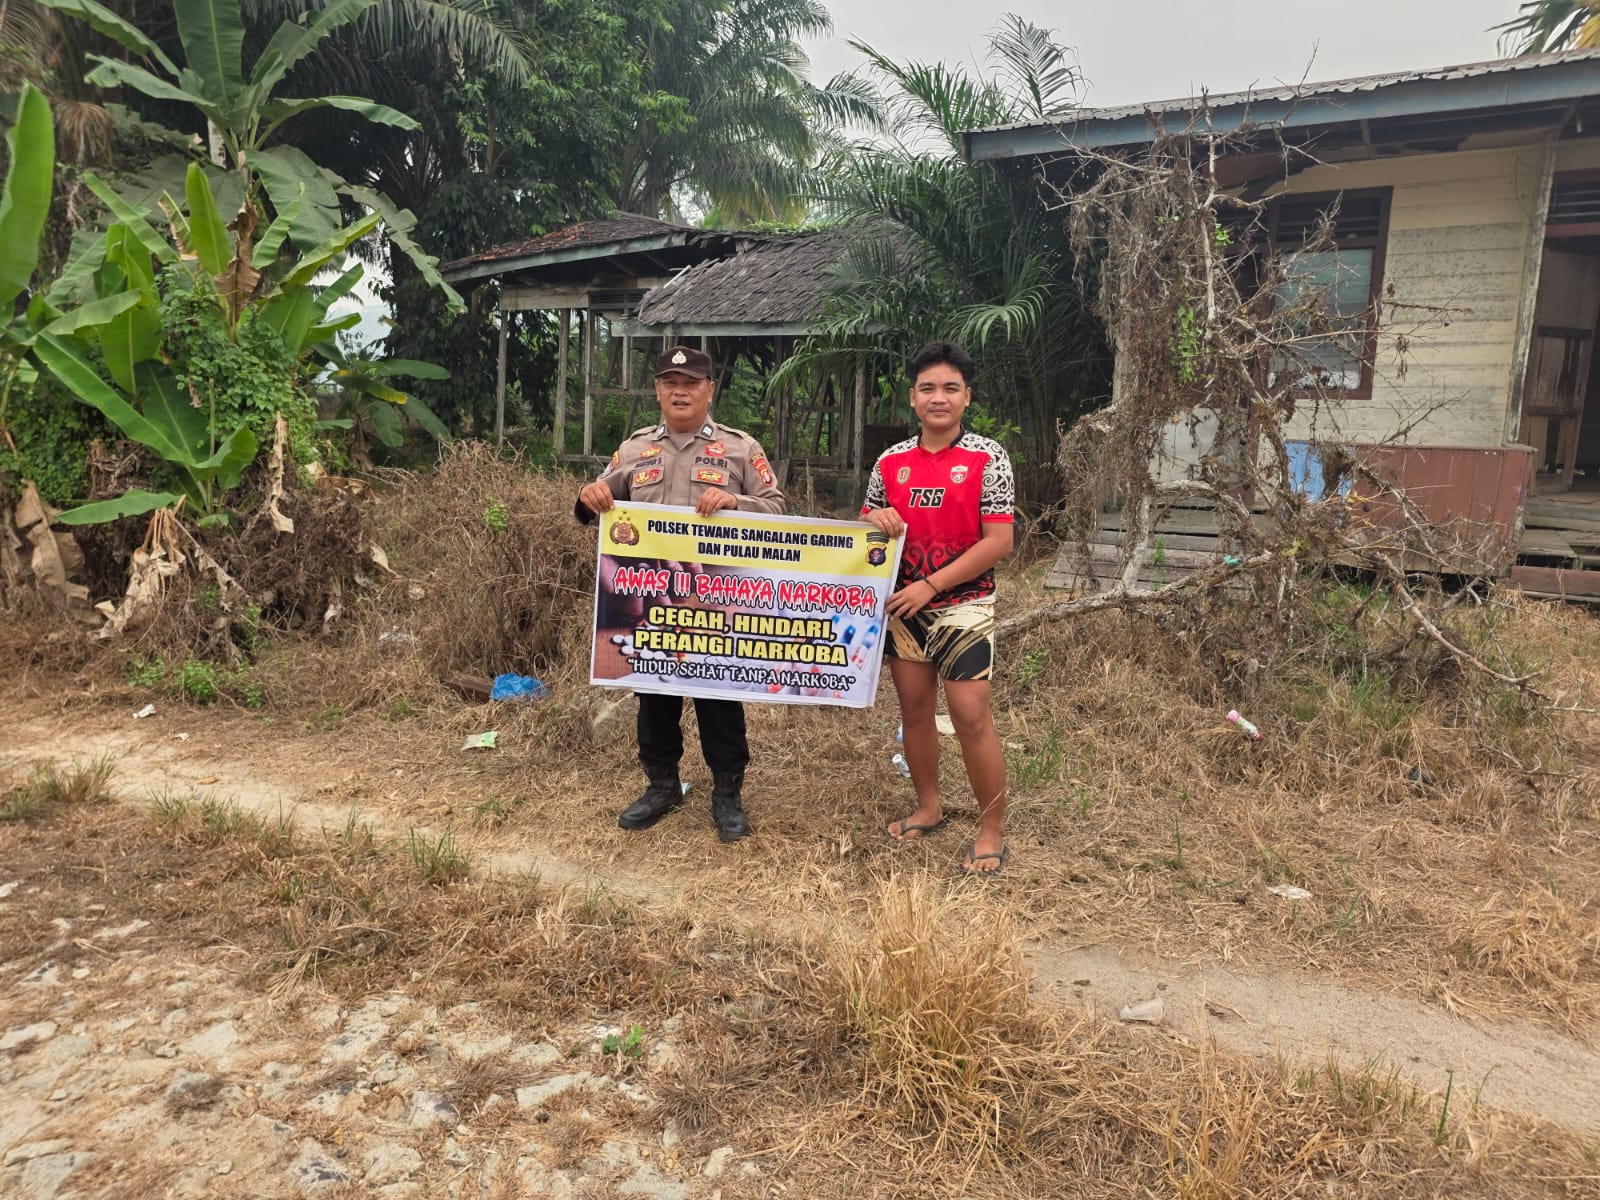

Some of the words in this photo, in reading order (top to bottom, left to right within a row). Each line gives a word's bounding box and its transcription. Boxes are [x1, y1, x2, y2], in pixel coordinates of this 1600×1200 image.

[695, 457, 728, 469] POLRI
[909, 487, 945, 508] TSG
[647, 519, 689, 536] POLSEK
[691, 523, 739, 540] TEWANG
[741, 528, 808, 546] SANGALANG
[810, 534, 854, 549] GARING
[698, 541, 721, 556] DAN
[723, 544, 759, 559] PULAU
[762, 547, 801, 562] MALAN
[614, 566, 671, 598] AWAS
[695, 573, 775, 609] BAHAYA
[778, 580, 877, 617] NARKOBA
[648, 605, 731, 633] CEGAH,
[733, 613, 837, 641] HINDARI,
[634, 629, 734, 656] PERANGI
[737, 638, 848, 666] NARKOBA
[679, 661, 726, 680] SEHAT
[729, 665, 778, 685] TANPA
